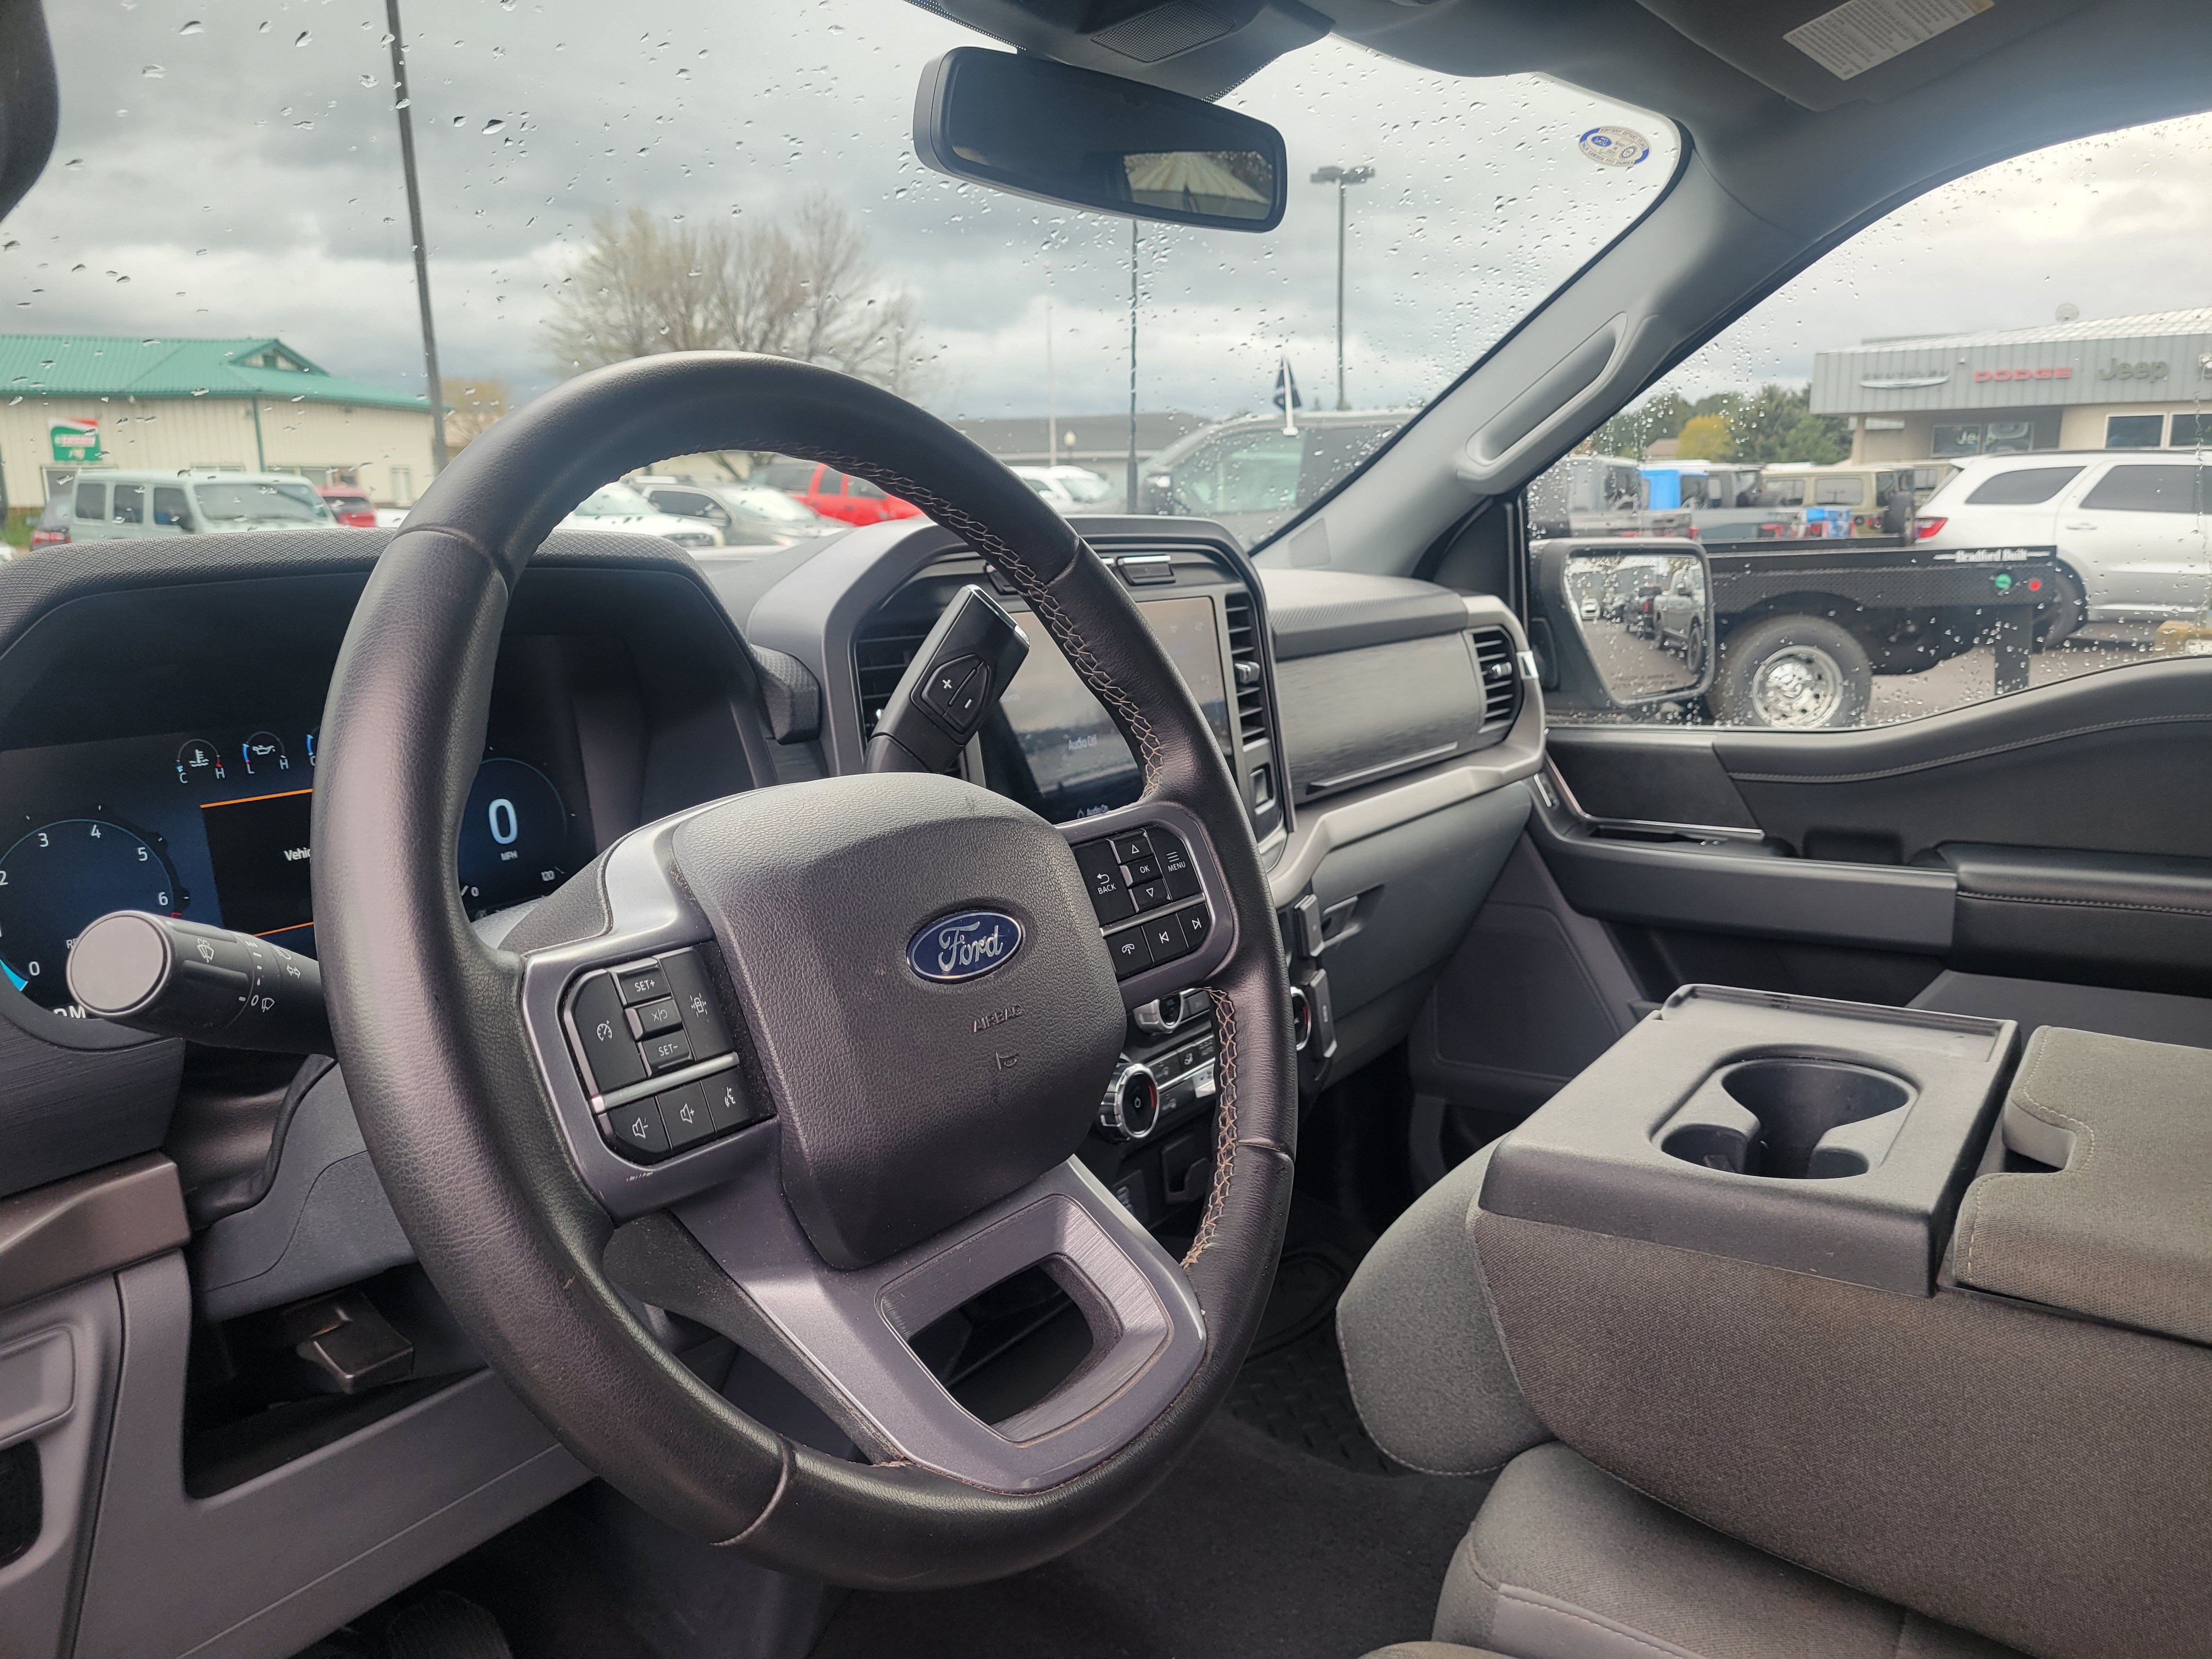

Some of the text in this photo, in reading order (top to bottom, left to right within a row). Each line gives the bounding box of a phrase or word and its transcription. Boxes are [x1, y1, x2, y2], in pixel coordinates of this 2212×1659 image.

[1974, 366, 2072, 382] DODGE
[2099, 358, 2169, 383] Jeep
[1955, 548, 2027, 563] Bradford Built
[1069, 738, 1087, 751] Audio
[247, 764, 255, 774] L
[279, 758, 289, 770] H
[179, 772, 188, 783] C
[215, 768, 225, 778] H
[488, 798, 518, 844] 0
[91, 825, 101, 838] 4
[38, 833, 49, 848] 3
[138, 847, 148, 861] 5
[284, 847, 311, 861] Vehic
[501, 850, 518, 861] MPH
[1140, 865, 1150, 873] OK
[1167, 861, 1186, 872] MENU
[0, 871, 9, 885] 2
[471, 887, 479, 896] 0
[1098, 883, 1117, 894] BACK
[159, 891, 168, 906] 6
[938, 921, 1003, 971] Ford
[29, 961, 40, 976] 0
[635, 979, 656, 992] SET+
[972, 1005, 1023, 1032] AIRBAG
